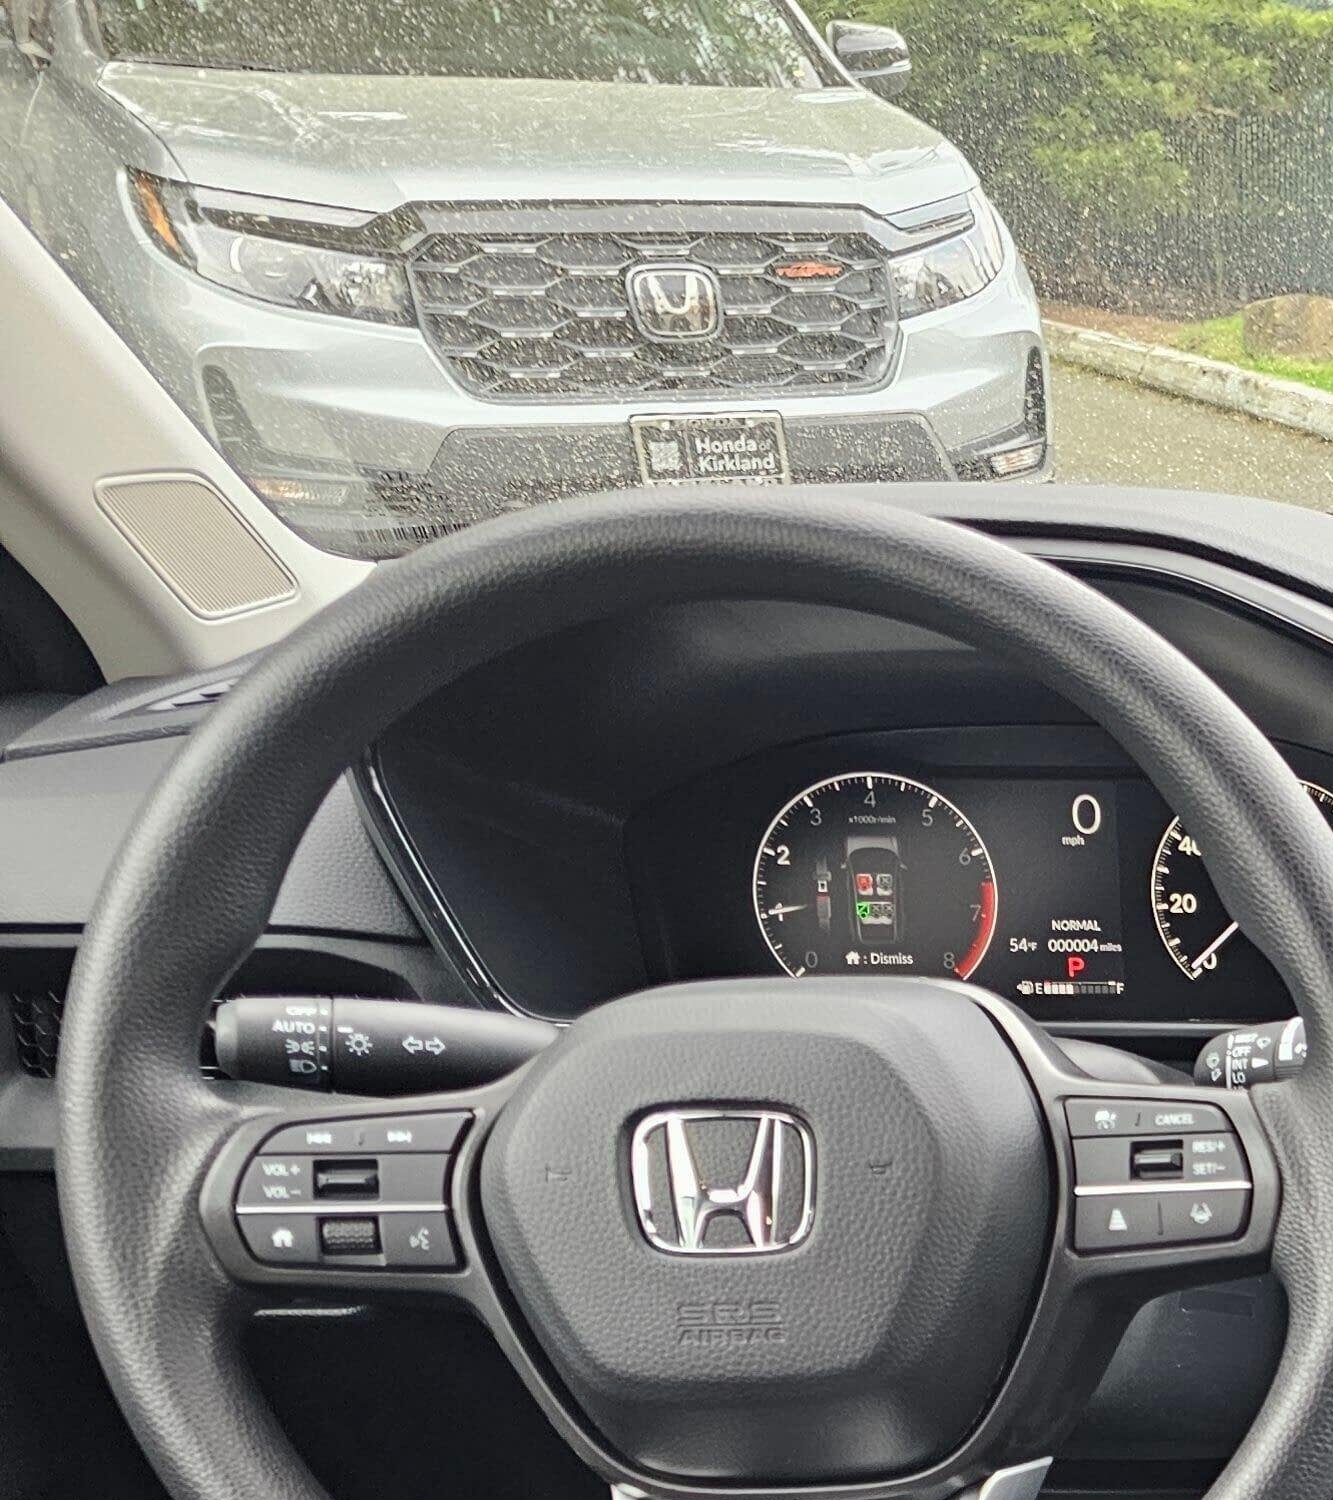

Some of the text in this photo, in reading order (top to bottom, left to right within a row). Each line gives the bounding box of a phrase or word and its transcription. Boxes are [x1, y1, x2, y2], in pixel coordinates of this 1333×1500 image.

[695, 433, 758, 453] Honda
[699, 452, 776, 473] Kirkland
[864, 792, 876, 808] 4
[810, 811, 822, 826] 3
[921, 810, 933, 827] 5
[1072, 794, 1101, 834] 0
[1062, 836, 1085, 847] mph
[776, 846, 790, 865] 2
[959, 848, 971, 865] 6
[1169, 893, 1197, 914] 20
[970, 904, 981, 922] 7
[1052, 919, 1102, 932] NORMAL
[1048, 939, 1099, 952] 000004
[804, 952, 818, 967] 0
[871, 952, 913, 965] Dismiss
[943, 953, 955, 969] 8
[1068, 957, 1085, 978] P
[1035, 983, 1043, 994] E
[1116, 983, 1125, 994] F
[272, 1020, 315, 1034] AUTO
[1232, 1046, 1252, 1058] OFF
[1232, 1059, 1249, 1070] INT
[1232, 1072, 1246, 1084] LO
[1155, 1113, 1194, 1126] CANCEL
[677, 1302, 782, 1324] SRS
[678, 1328, 787, 1346] AIRBAG
